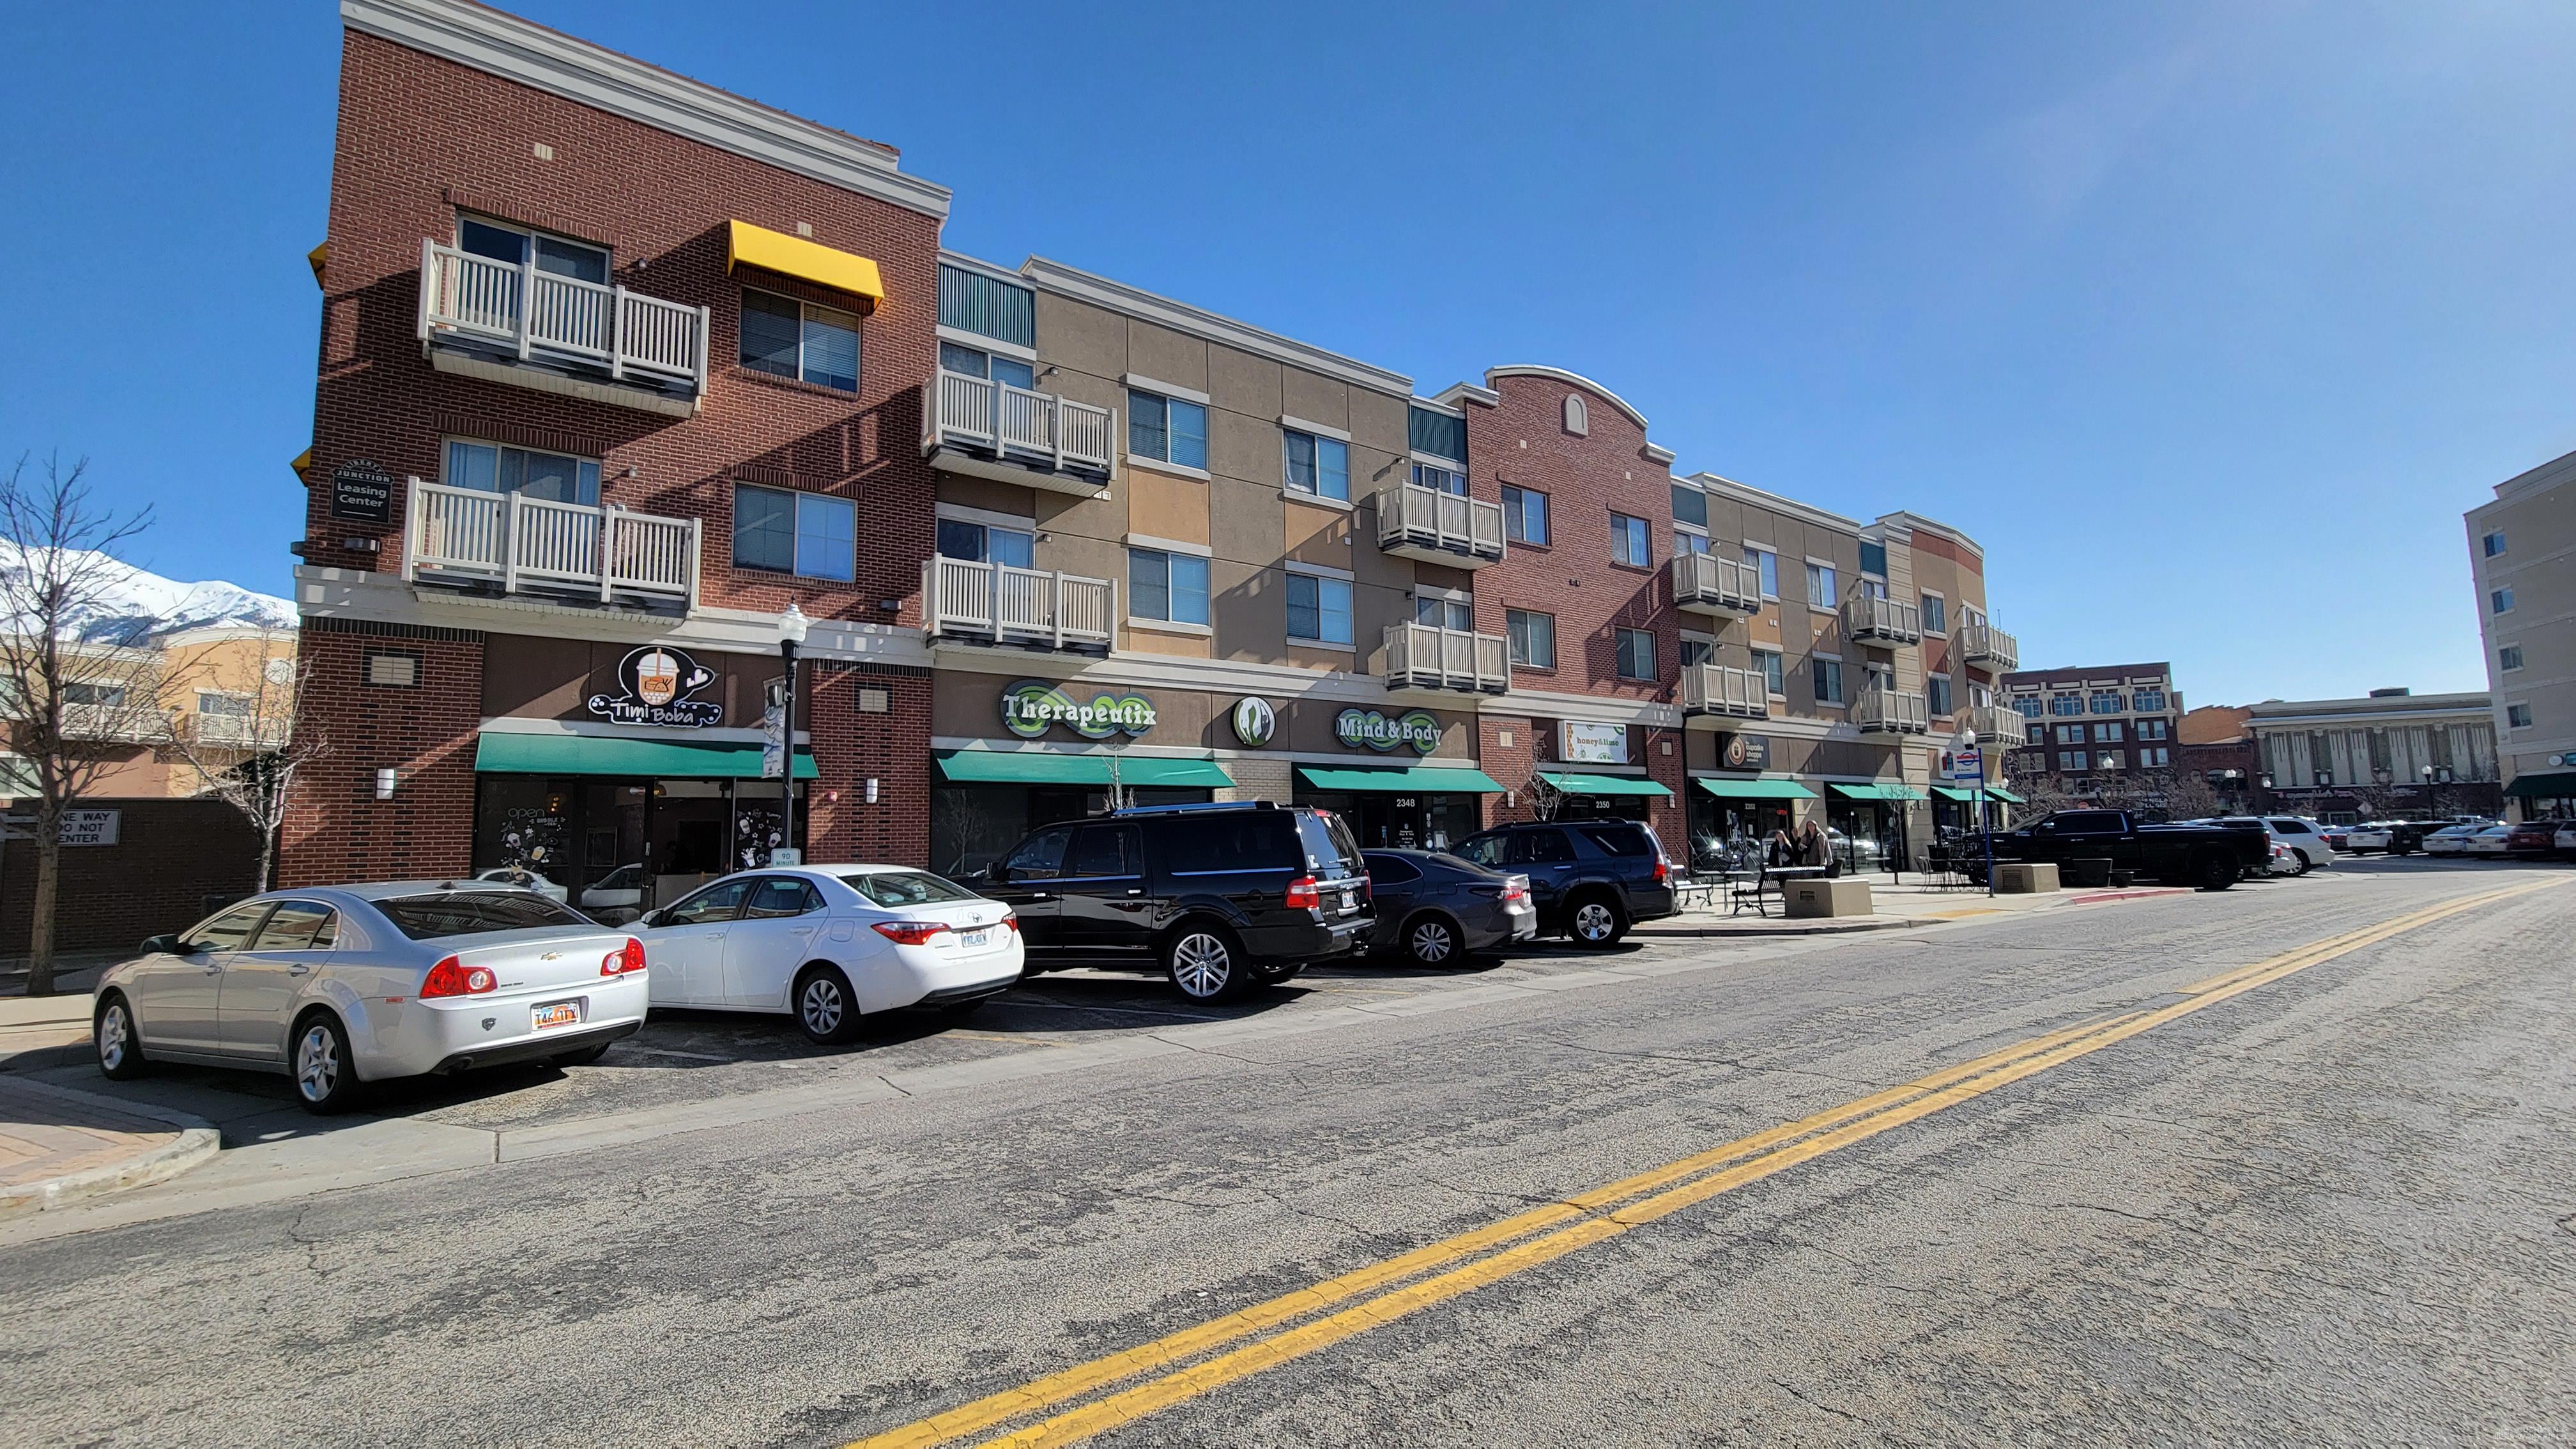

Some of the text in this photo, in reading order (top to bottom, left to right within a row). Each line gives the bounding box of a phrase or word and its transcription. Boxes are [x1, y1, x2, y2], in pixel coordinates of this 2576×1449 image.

[345, 460, 382, 473] LIBERTY
[337, 470, 390, 482] JUNCTION
[337, 482, 387, 498] Leasing
[339, 494, 383, 507] Center
[611, 703, 694, 723] Timi Boba
[1003, 694, 1156, 727] Therapeutix
[1339, 718, 1442, 746] Mind & Body
[1397, 799, 1415, 807] 2348
[1596, 801, 1610, 809] 2350
[84, 813, 111, 822] WAY
[509, 808, 544, 820] open
[79, 823, 105, 832] NOT
[59, 834, 100, 843] ENTER
